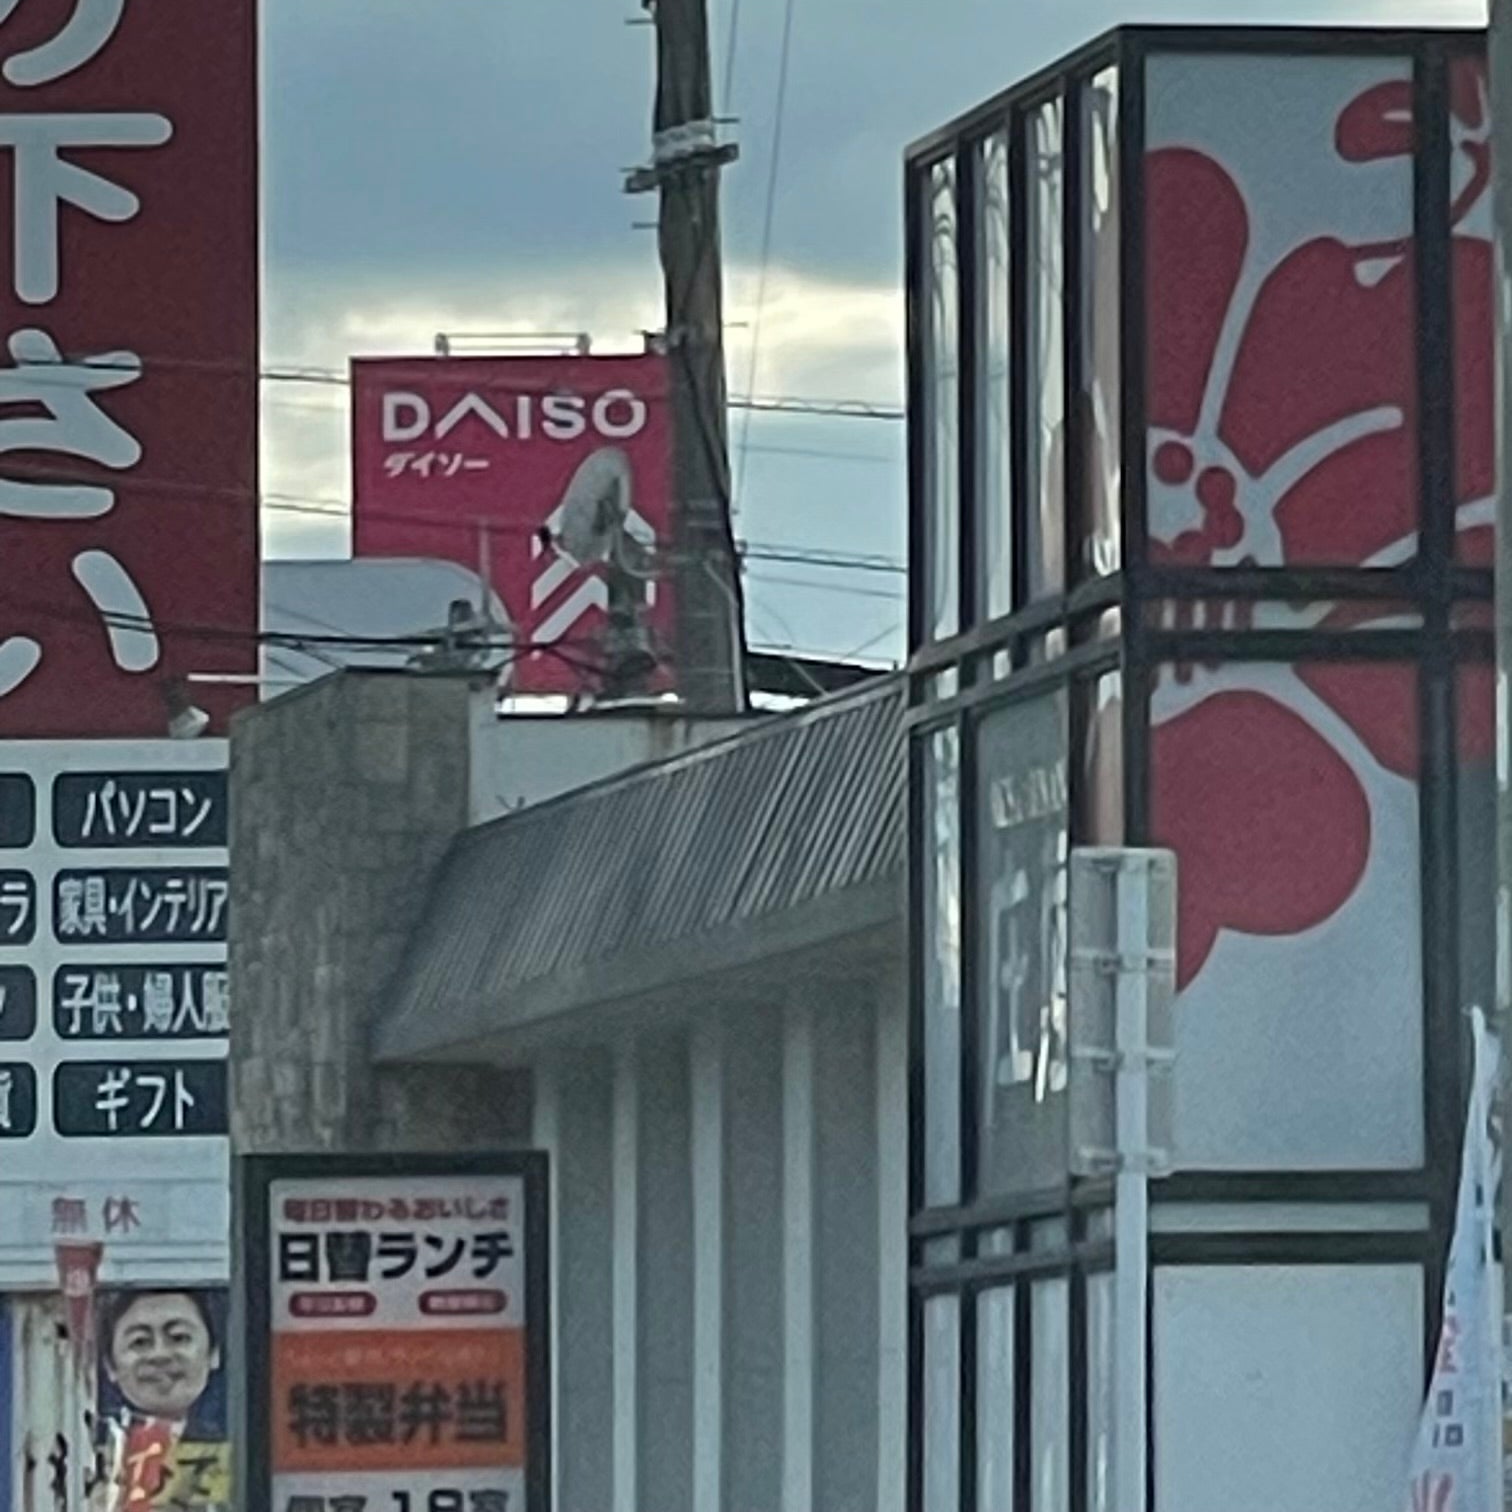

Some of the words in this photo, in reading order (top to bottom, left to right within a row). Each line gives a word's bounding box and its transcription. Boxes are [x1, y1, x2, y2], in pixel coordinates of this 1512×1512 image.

[382, 389, 646, 441] DAISO
[383, 452, 489, 478] ダイソー
[81, 781, 212, 837] パソコン
[95, 1069, 195, 1131] ギフト
[279, 1231, 514, 1282] 日替ランチ
